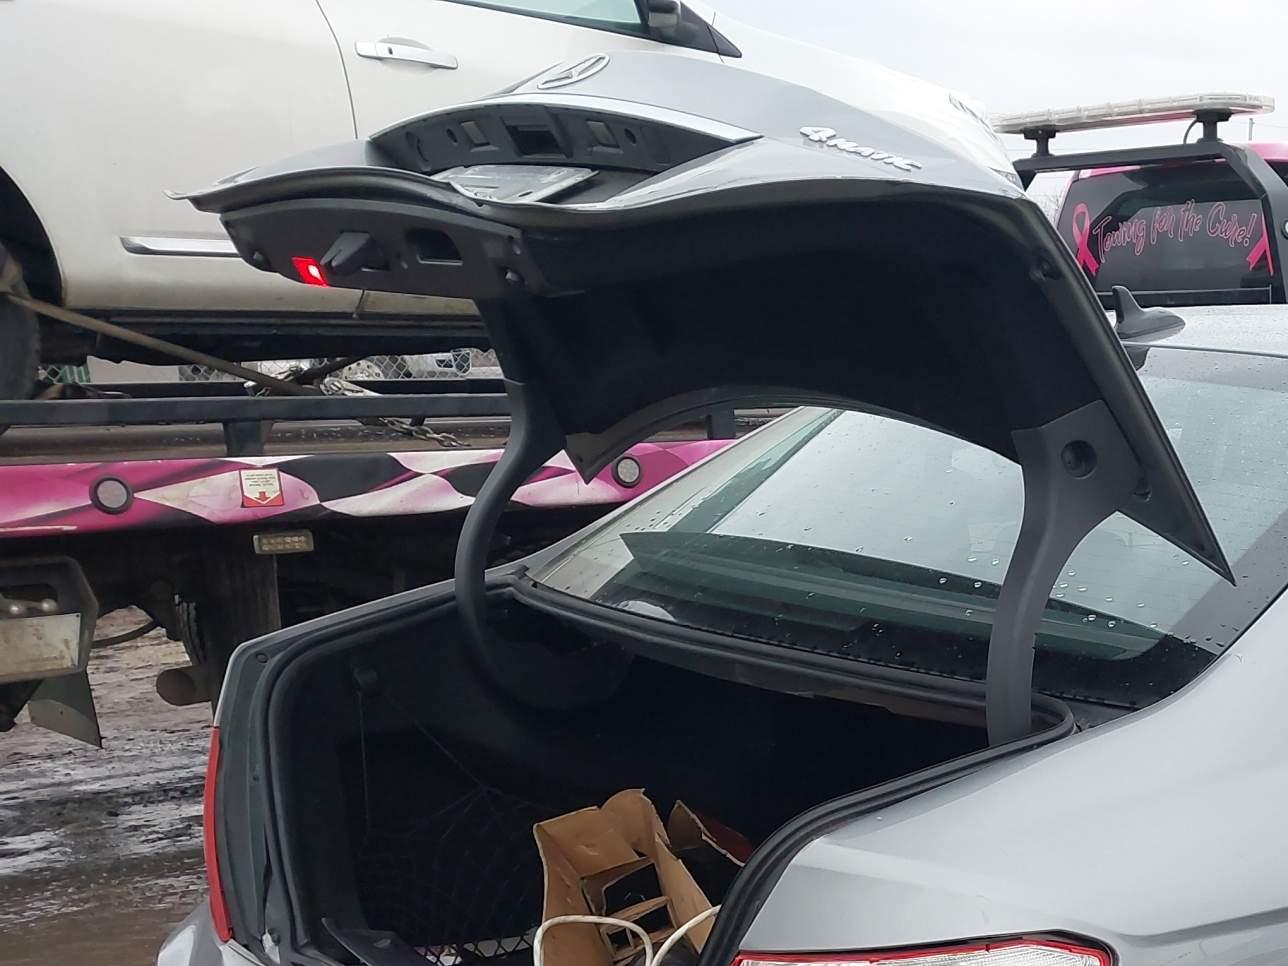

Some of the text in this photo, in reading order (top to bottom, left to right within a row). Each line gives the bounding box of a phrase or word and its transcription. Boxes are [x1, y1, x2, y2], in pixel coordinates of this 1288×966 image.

[1092, 198, 1258, 263] Towing for the Cure!
